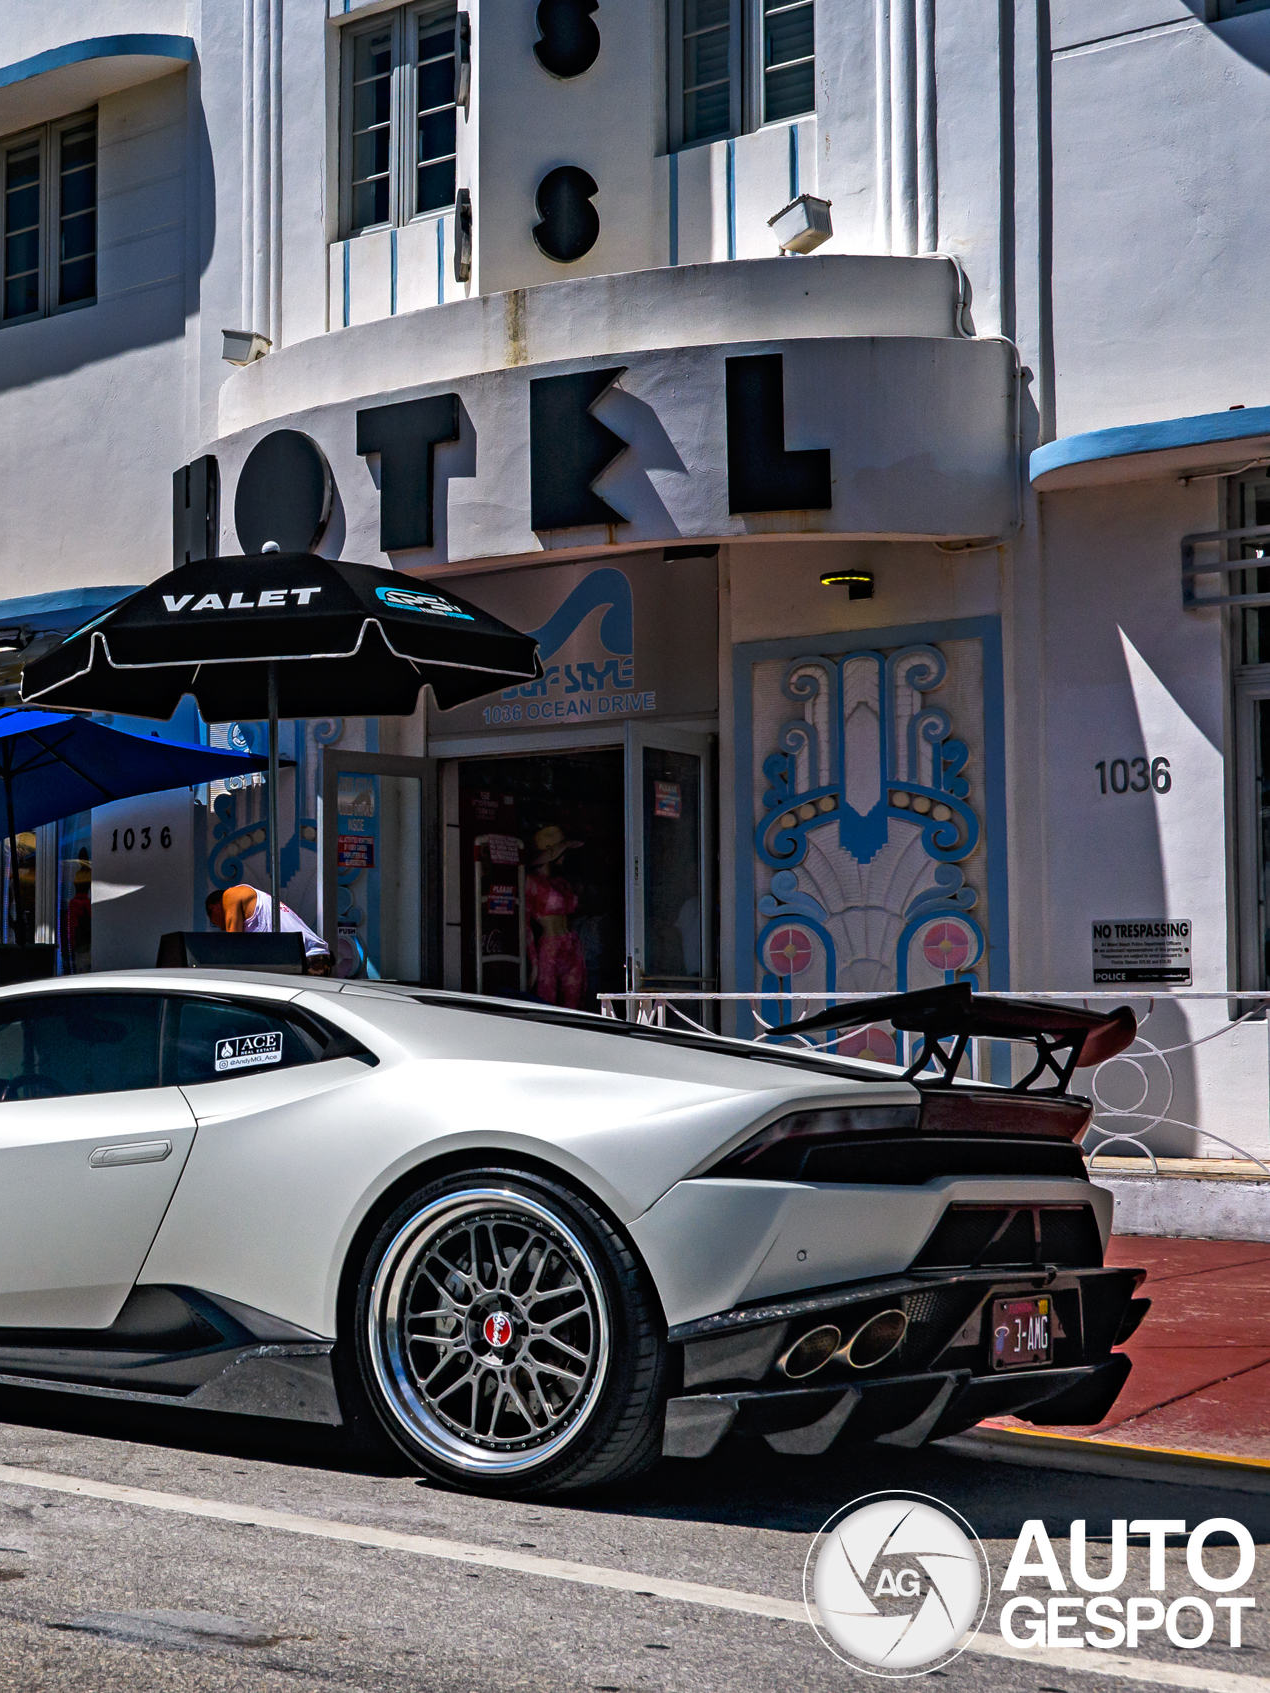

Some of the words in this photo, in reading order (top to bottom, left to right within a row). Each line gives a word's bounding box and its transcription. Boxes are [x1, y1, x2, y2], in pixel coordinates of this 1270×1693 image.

[172, 352, 832, 570] HOTEL
[162, 587, 322, 612] VALET
[564, 657, 634, 694] STYLE
[482, 704, 522, 724] 1036
[527, 698, 591, 720] OCEAN
[598, 691, 656, 714] DRIVE
[1095, 756, 1172, 794] 1036
[111, 826, 172, 851] 1036
[492, 885, 514, 893] PLEASE
[1093, 924, 1112, 938] NO
[1114, 923, 1189, 938] TRESPASSING
[1095, 972, 1126, 981] POLICE
[241, 1034, 277, 1050] ACE
[1014, 1315, 1048, 1352] 3-AMG
